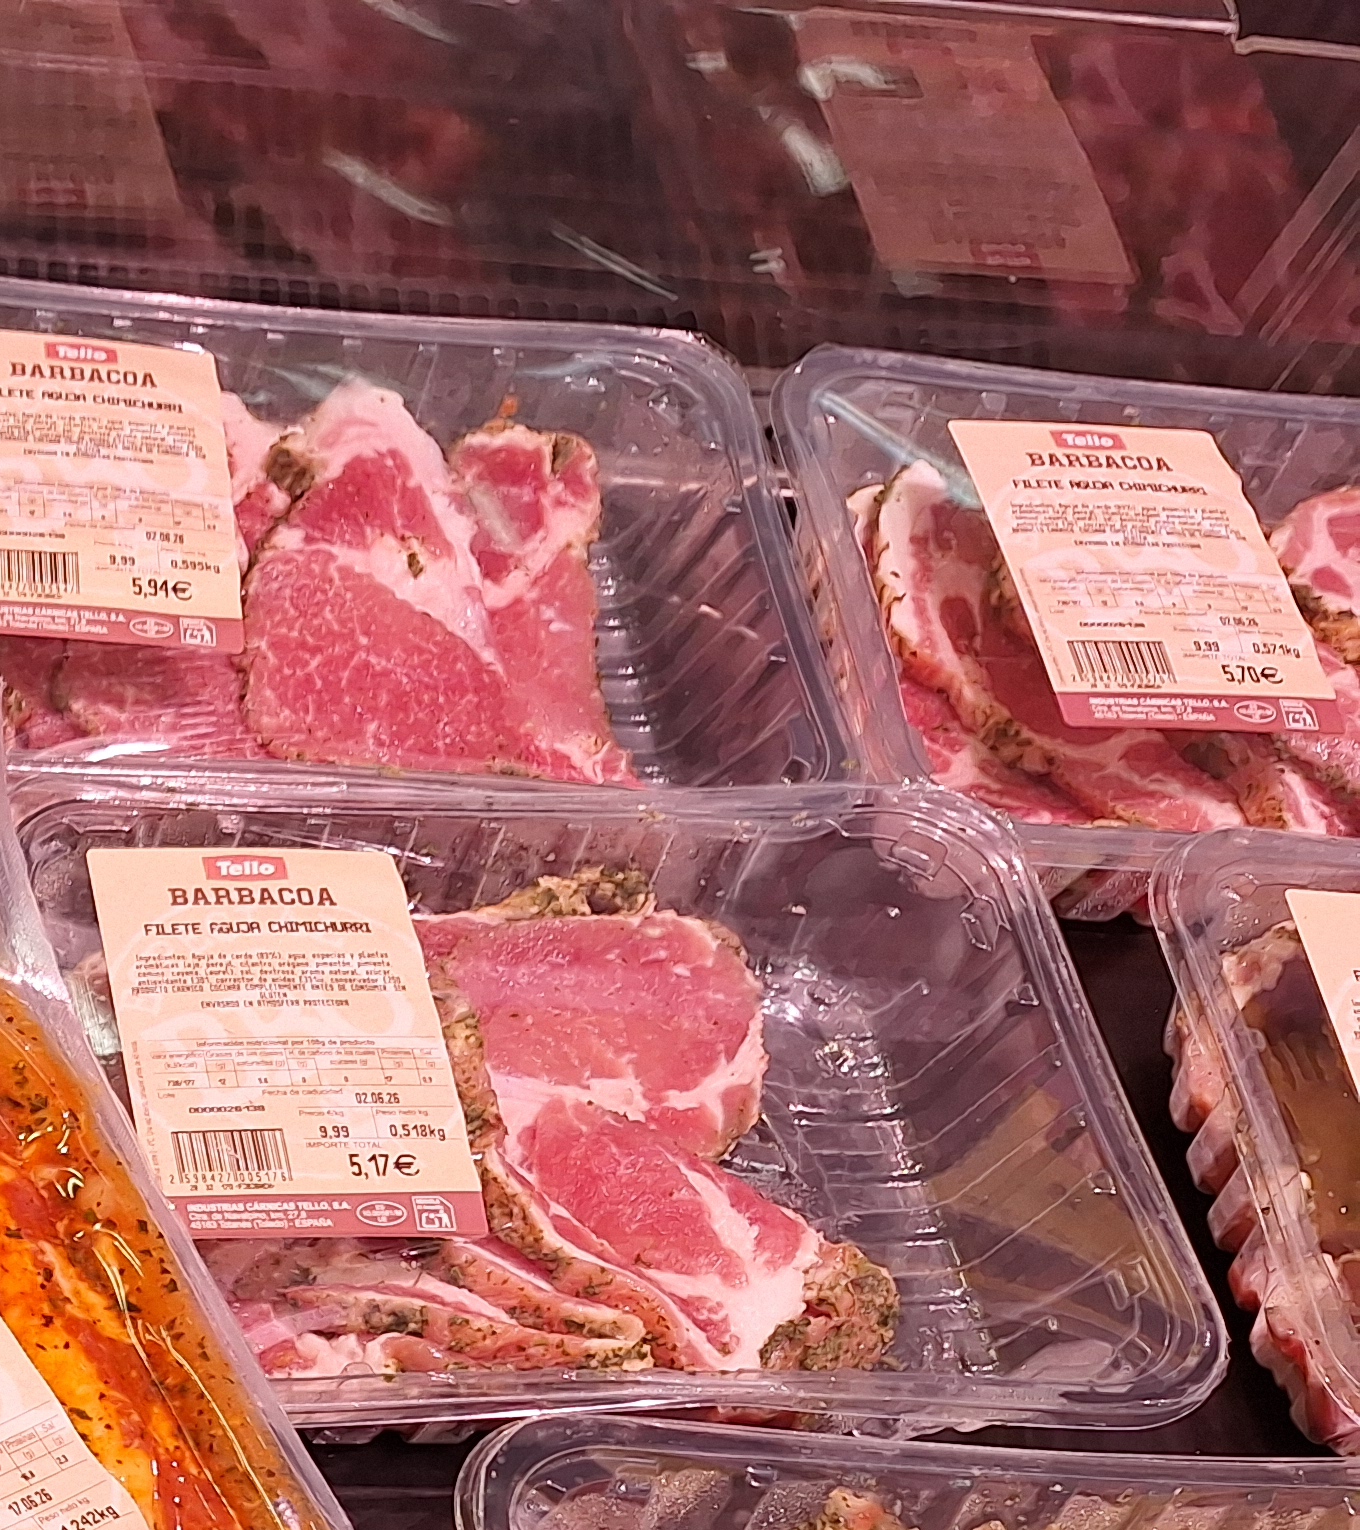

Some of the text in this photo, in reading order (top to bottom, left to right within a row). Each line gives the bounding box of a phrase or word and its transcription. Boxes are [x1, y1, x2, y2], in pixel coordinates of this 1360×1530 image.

[55, 344, 107, 362] Tello
[9, 360, 158, 388] BARBACOA
[1059, 432, 1116, 448] Tello
[1024, 451, 1174, 472] BARBACOA
[1010, 478, 1065, 489] FILETE
[131, 576, 193, 601] 5,94€
[1218, 663, 1286, 684] 5,70€
[214, 860, 277, 876] Tello
[166, 887, 337, 906] BARBACOA
[142, 922, 203, 936] FILETE
[266, 921, 372, 933] CHIMICHURRI
[354, 1092, 401, 1104] 02.06.26
[387, 1124, 448, 1141] 0,518kg
[346, 1153, 422, 1179] 5,17€
[185, 1202, 245, 1212] INDUSTRIAS
[5, 1486, 54, 1518] 17.06.26
